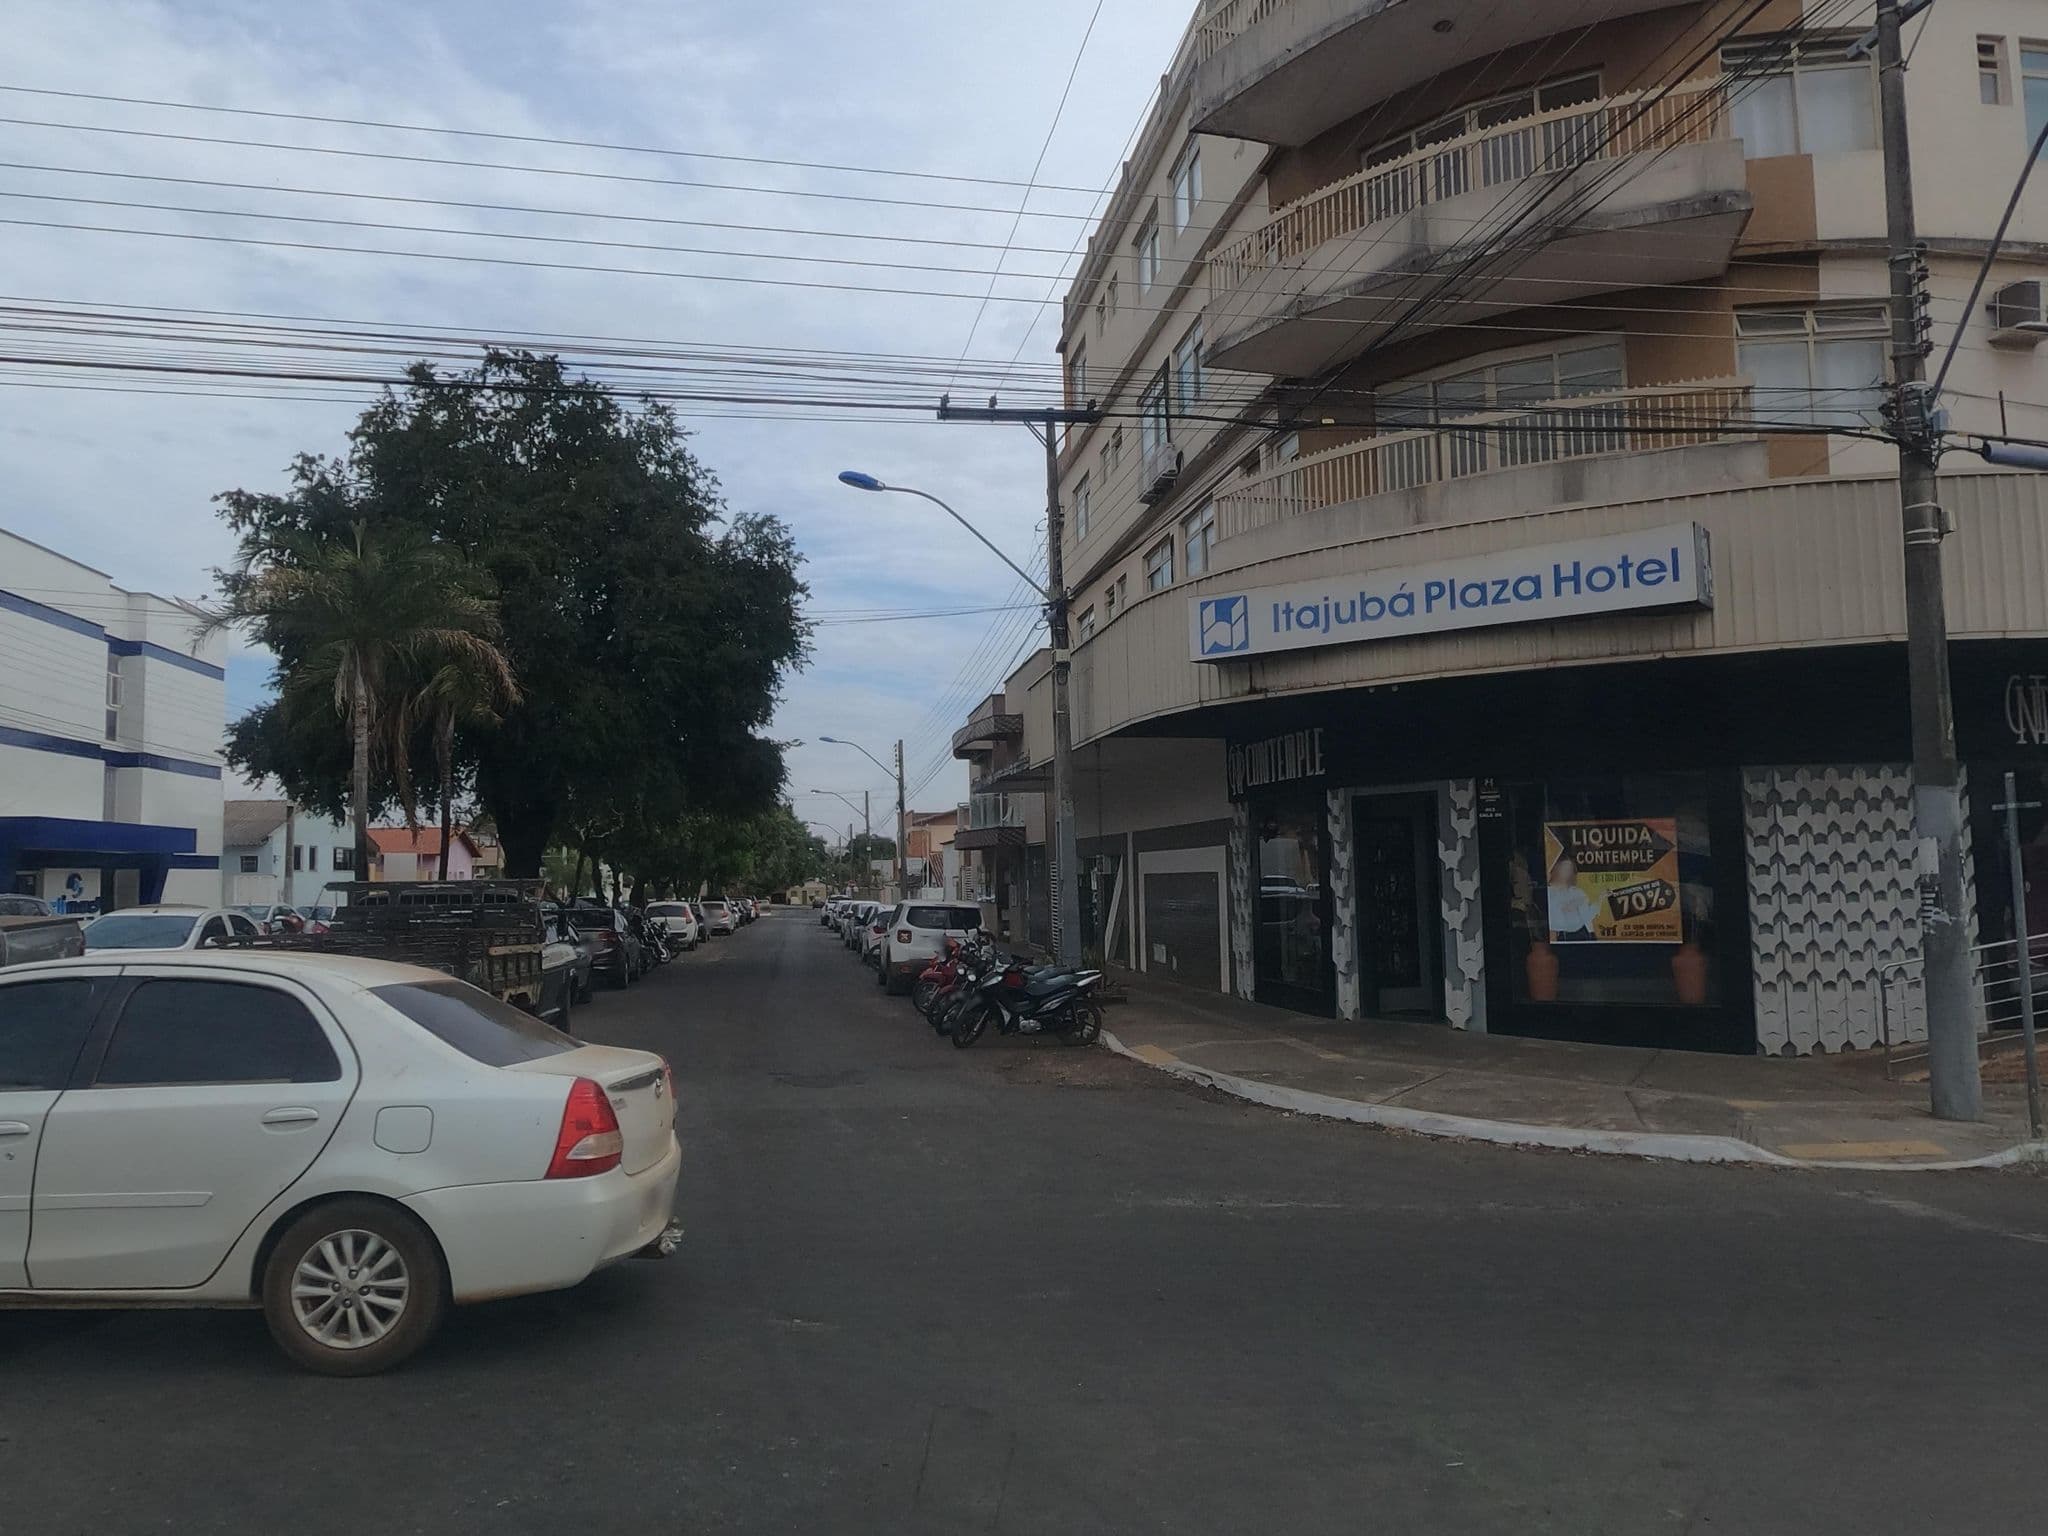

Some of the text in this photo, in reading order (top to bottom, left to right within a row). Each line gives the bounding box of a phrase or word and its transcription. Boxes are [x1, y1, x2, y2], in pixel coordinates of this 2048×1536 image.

[1272, 547, 1680, 634] Itajubá Plaza Hotel
[1245, 728, 1326, 786] CONTEMPLE
[1572, 825, 1653, 848] LIQUIDA
[1576, 849, 1654, 865] CONTEMPLE
[1617, 888, 1666, 915] 70%
